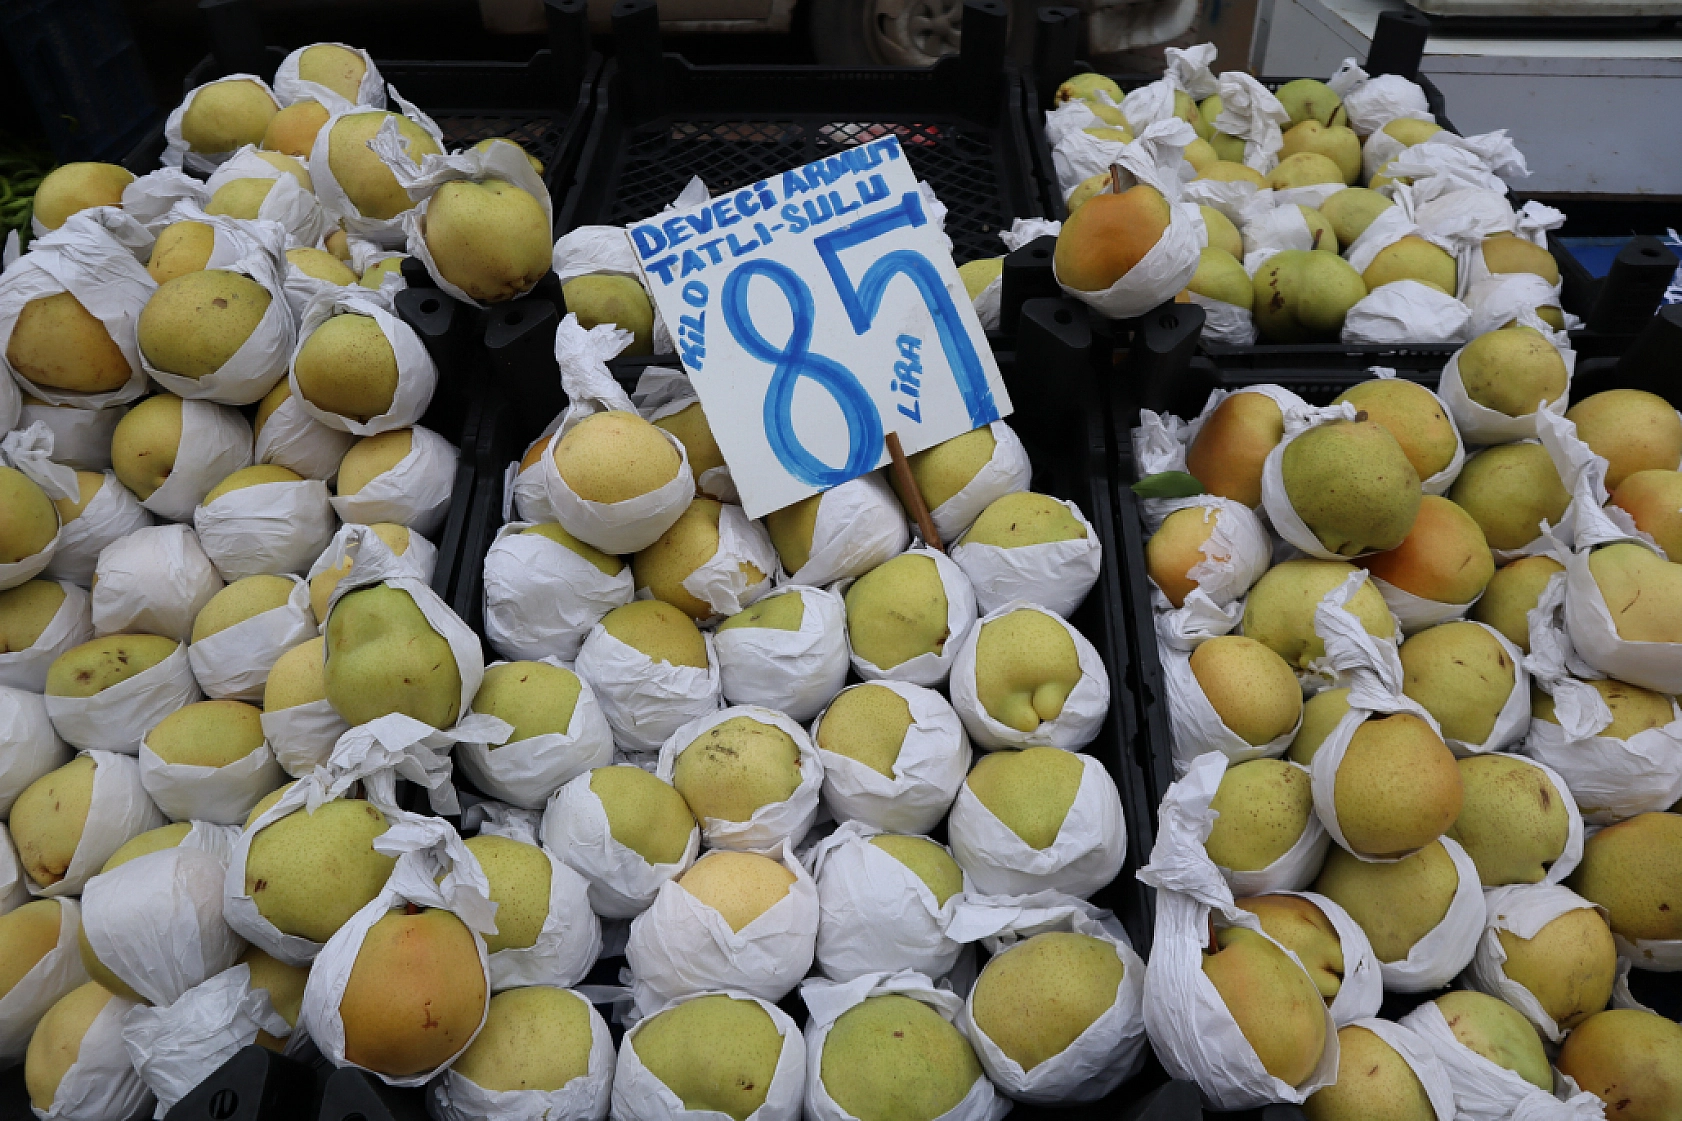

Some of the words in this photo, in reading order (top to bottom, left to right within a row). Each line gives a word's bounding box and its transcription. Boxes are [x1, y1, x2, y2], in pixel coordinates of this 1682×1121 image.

[782, 135, 899, 200] ARMUT
[645, 173, 890, 286] TATLI-SULU
[721, 192, 1000, 492] 85
